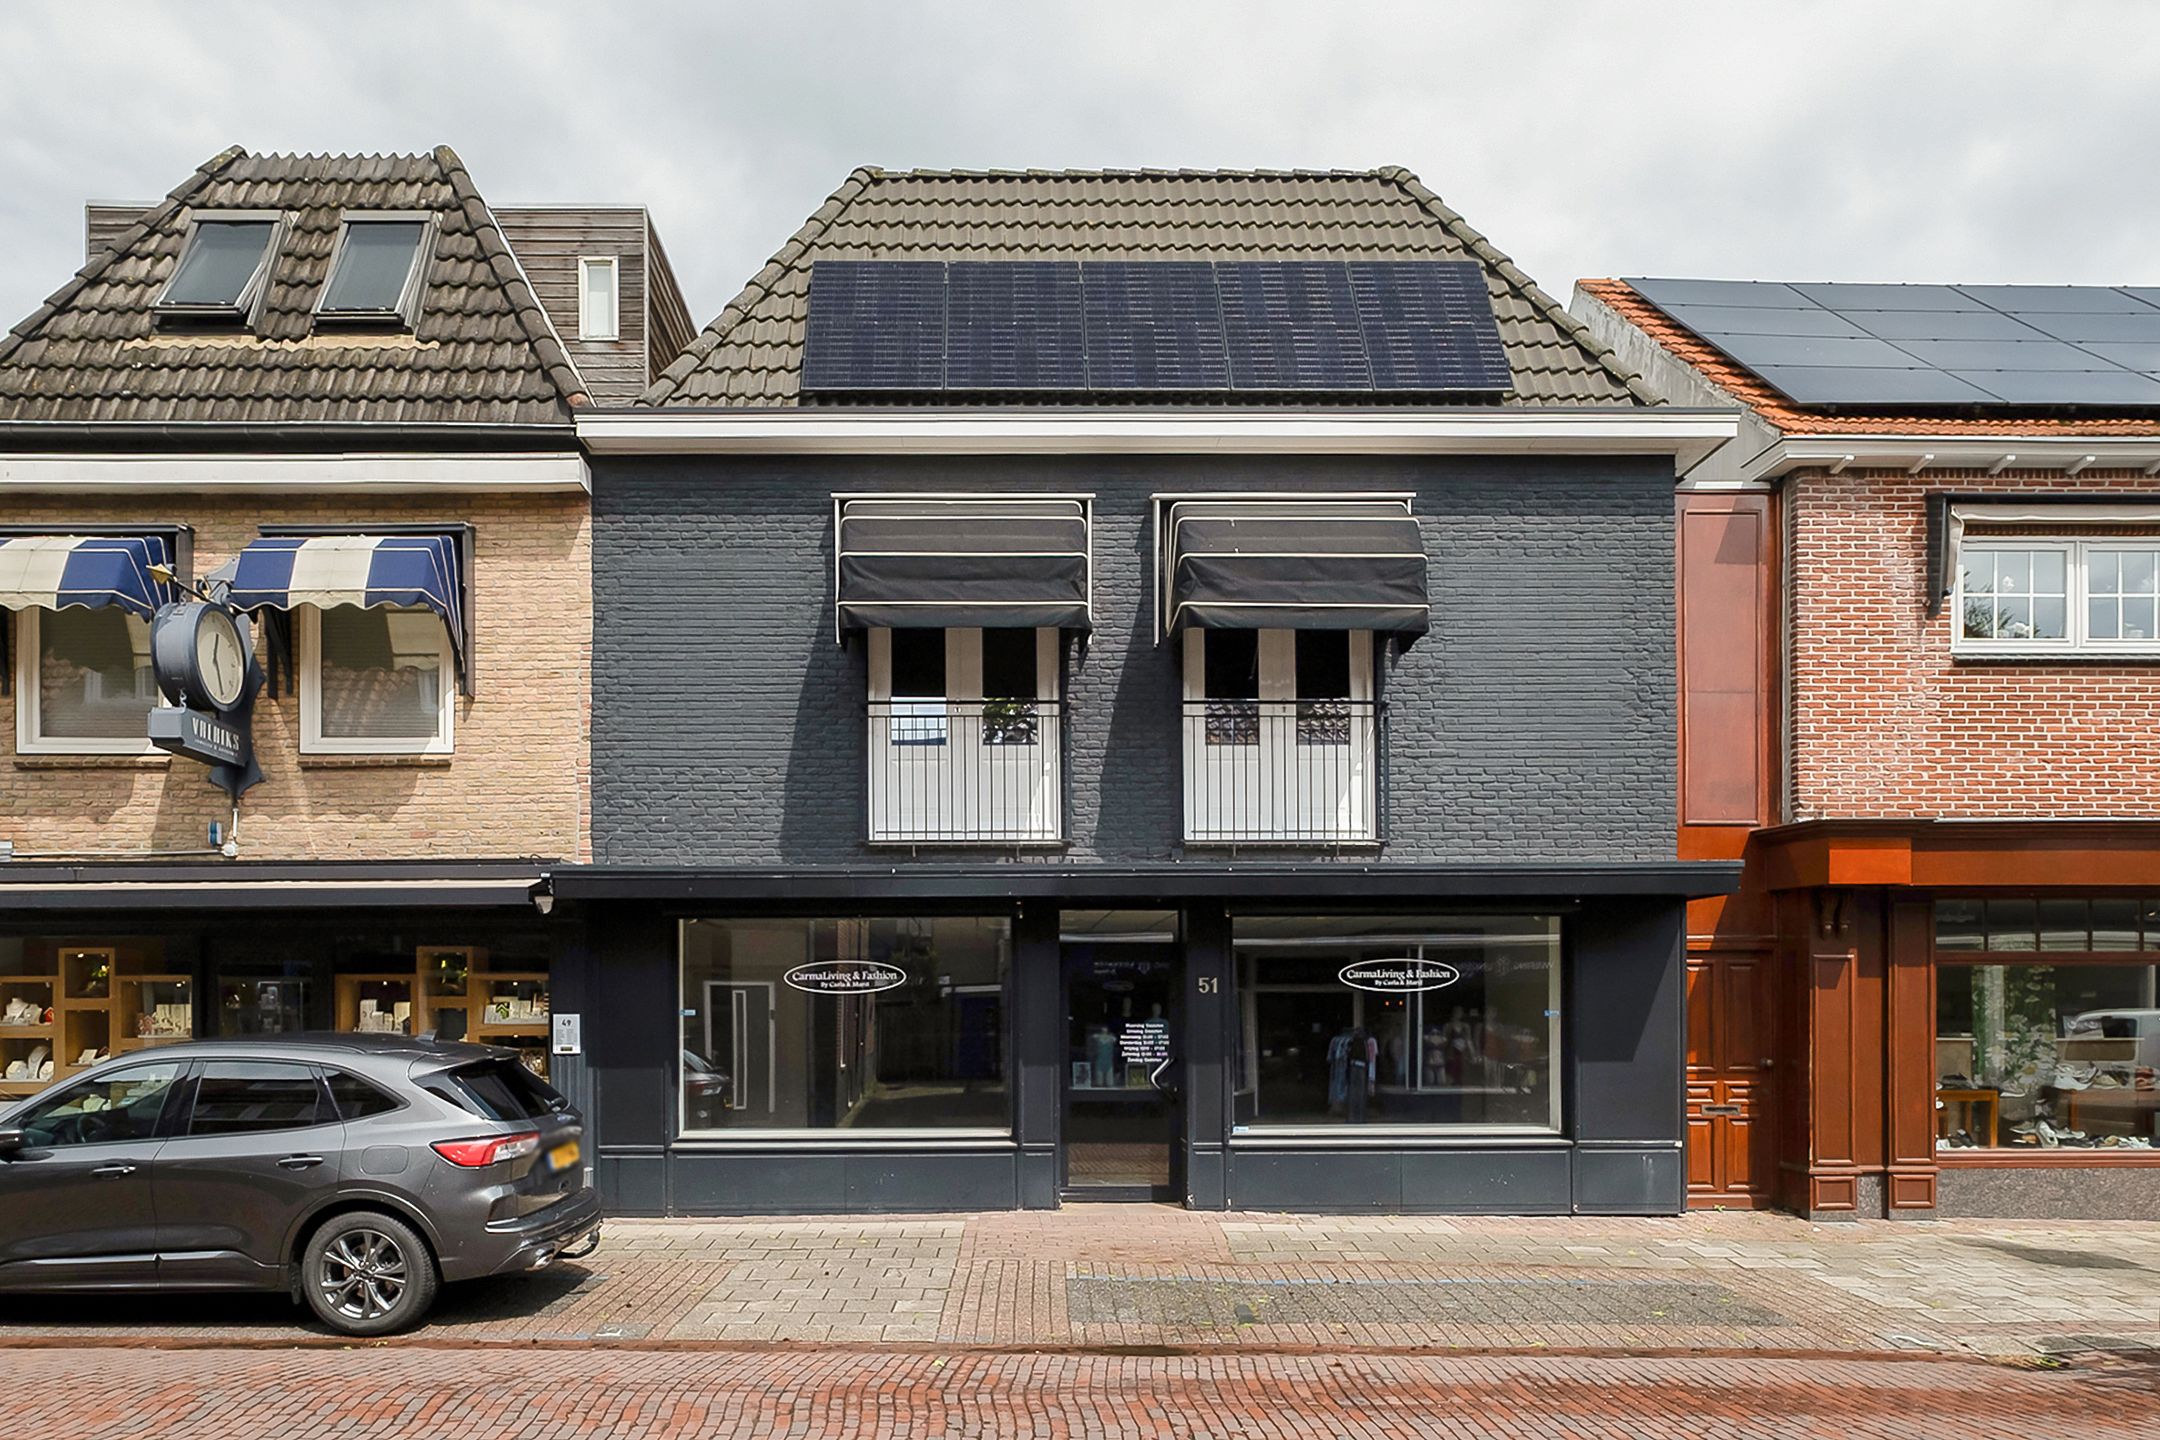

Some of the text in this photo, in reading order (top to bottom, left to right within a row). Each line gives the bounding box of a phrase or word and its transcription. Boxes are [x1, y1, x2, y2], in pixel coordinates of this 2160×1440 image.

[792, 970, 898, 982] CarmaLiving & Fashion
[1346, 969, 1451, 981] CarmaLiving & Fashion
[820, 981, 829, 989] By
[1198, 977, 1218, 994] 51
[1374, 979, 1382, 987] By
